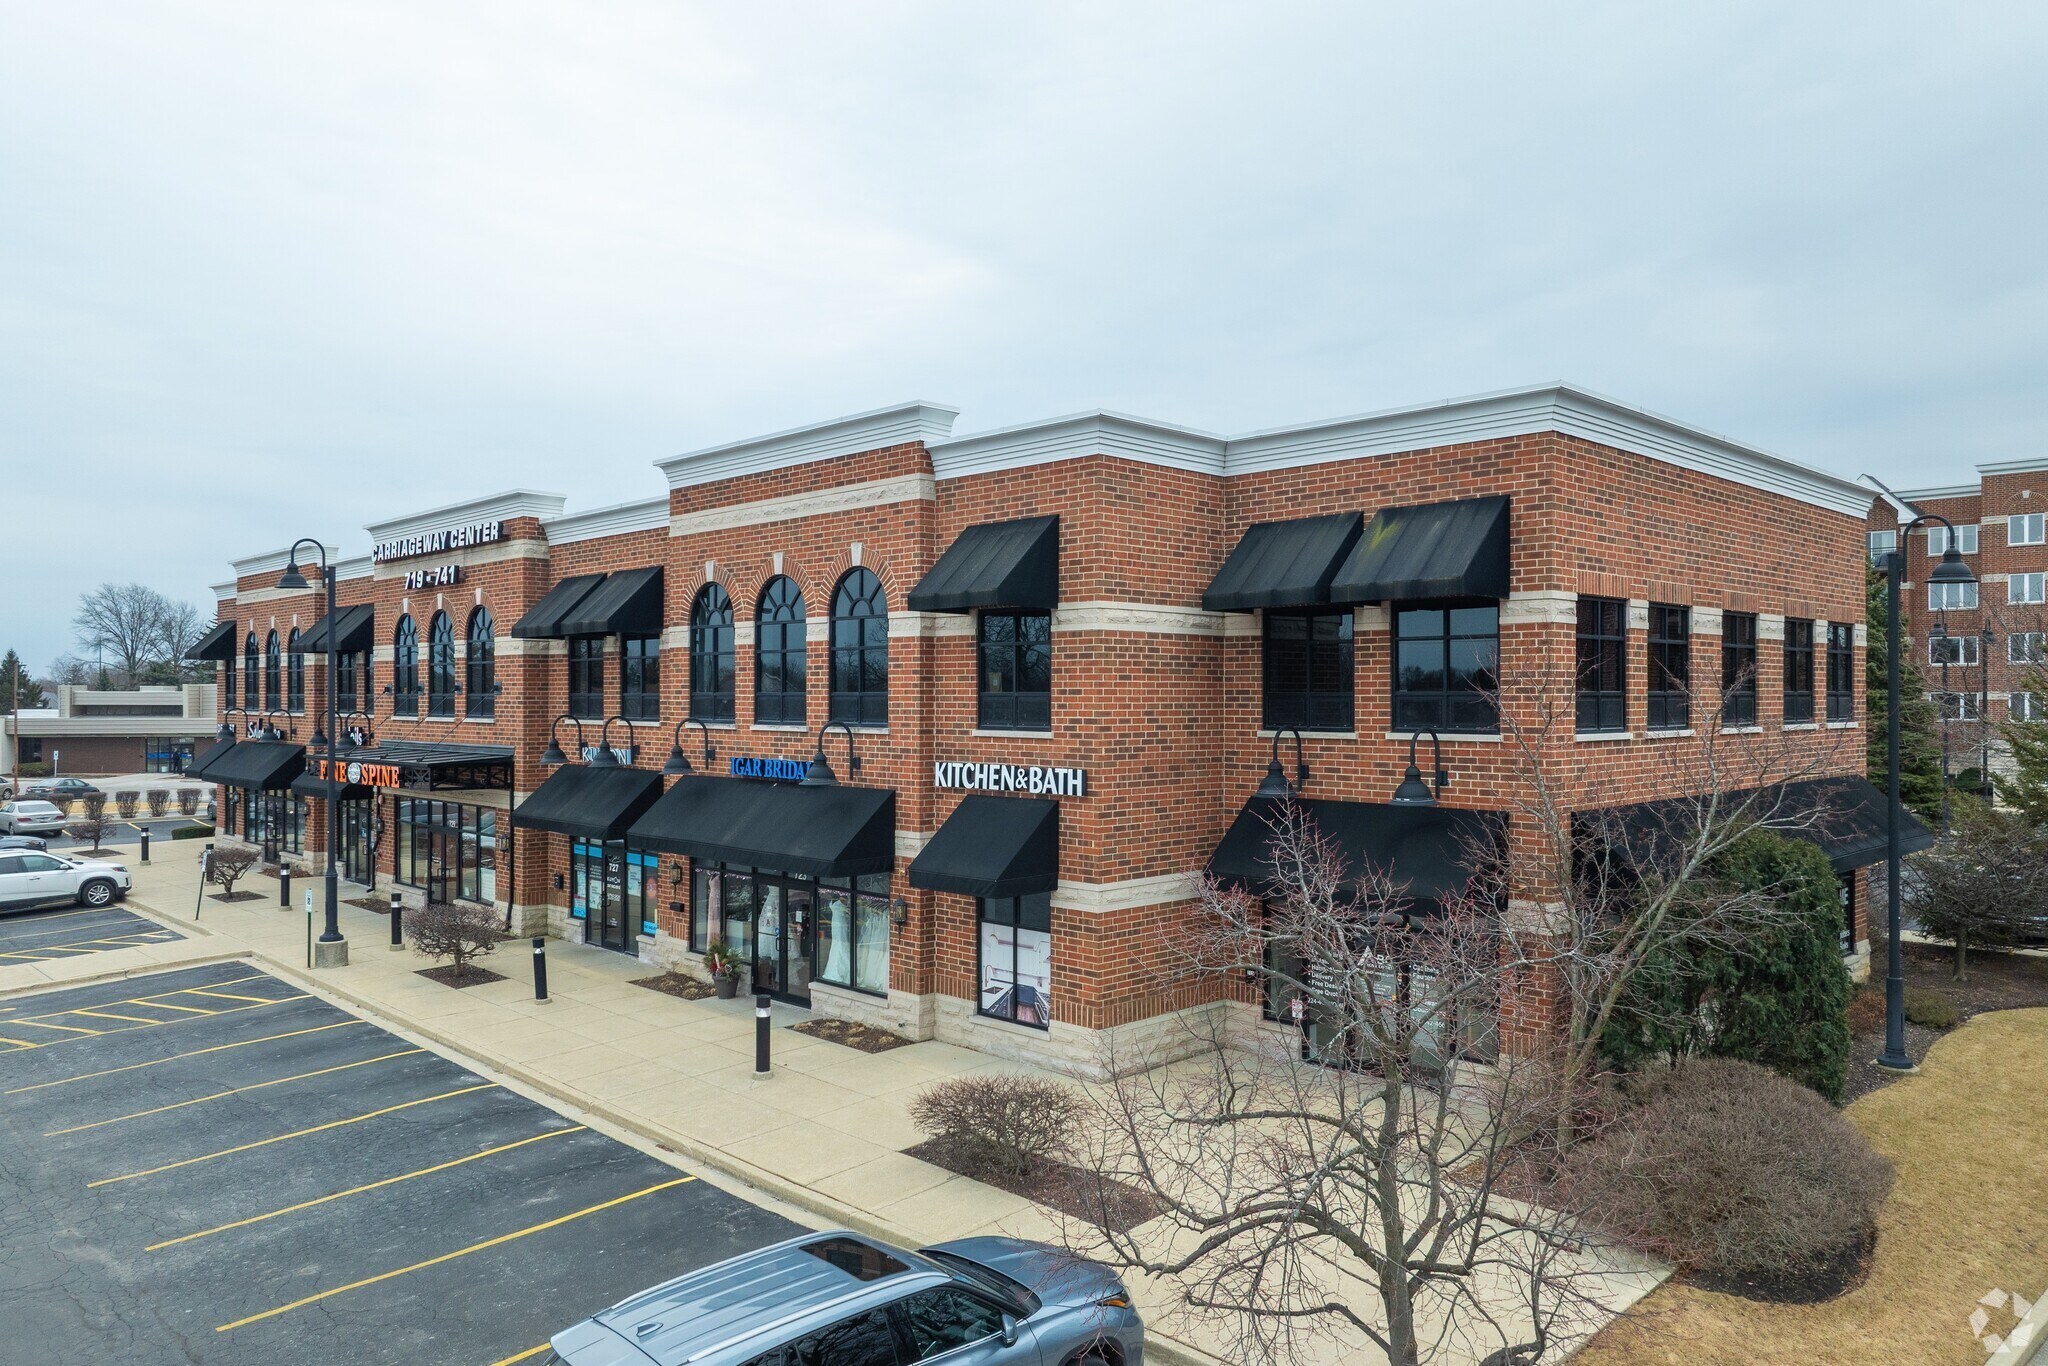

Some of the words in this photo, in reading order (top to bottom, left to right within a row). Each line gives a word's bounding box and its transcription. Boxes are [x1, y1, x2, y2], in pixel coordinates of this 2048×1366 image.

[371, 530, 449, 562] CARRIAGEWAY
[450, 523, 499, 549] CENTER
[404, 569, 424, 590] 719
[434, 564, 457, 586] 741
[582, 746, 628, 766] KUN
[730, 757, 763, 777] IGAR
[320, 760, 347, 783] FNE
[361, 763, 400, 788] SPINE
[935, 761, 1083, 797] KITCHEN&BATH
[608, 862, 619, 872] 727
[1311, 979, 1324, 987] Free
